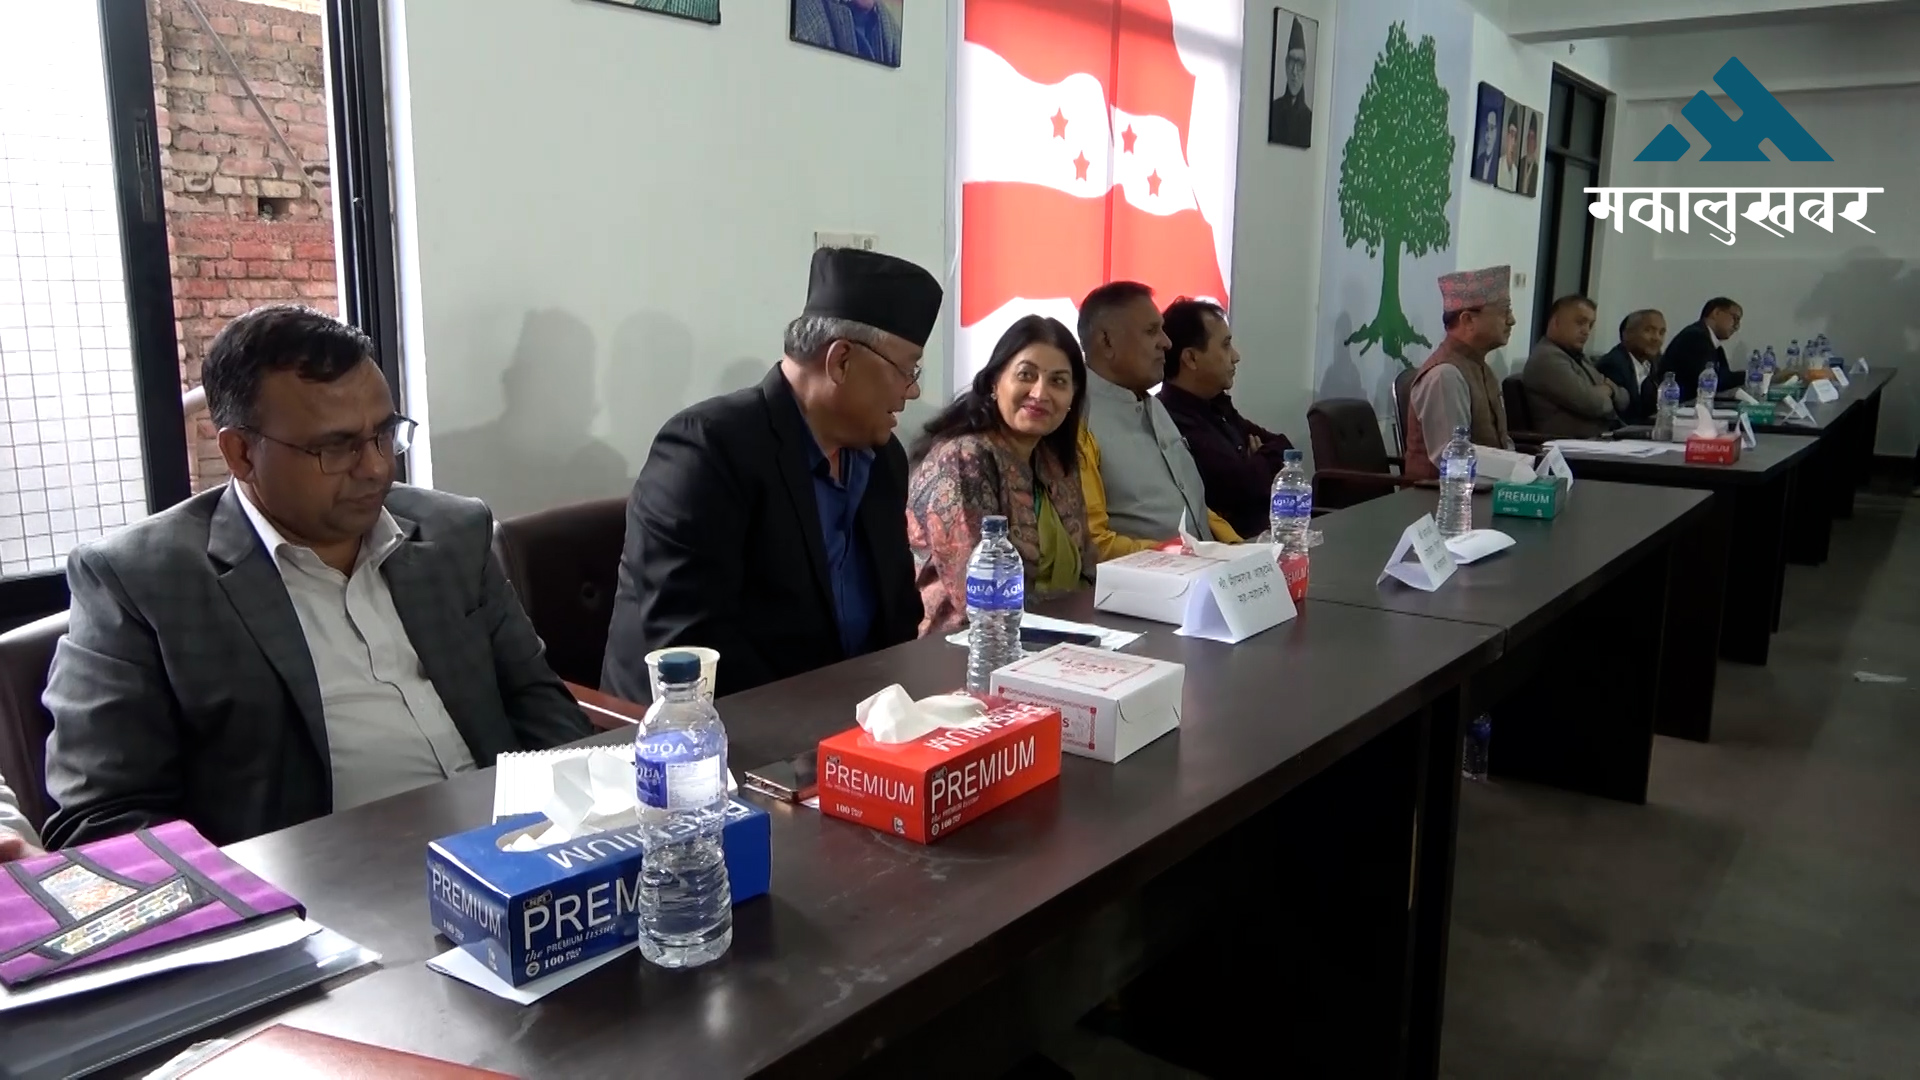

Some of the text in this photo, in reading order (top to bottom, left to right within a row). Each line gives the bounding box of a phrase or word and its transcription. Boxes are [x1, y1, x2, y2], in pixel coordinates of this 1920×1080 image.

[1497, 489, 1550, 504] PREMIUM
[1002, 583, 1023, 598] AQU
[825, 760, 914, 807] PREMIUM
[931, 735, 1035, 814] PREMIUM
[836, 803, 850, 815] 100
[432, 867, 501, 939] PREMIUM
[524, 872, 642, 950] PREM
[525, 949, 543, 963] the
[546, 934, 583, 954] PREMIUM
[585, 923, 616, 940] tissue
[544, 955, 565, 969] 100
